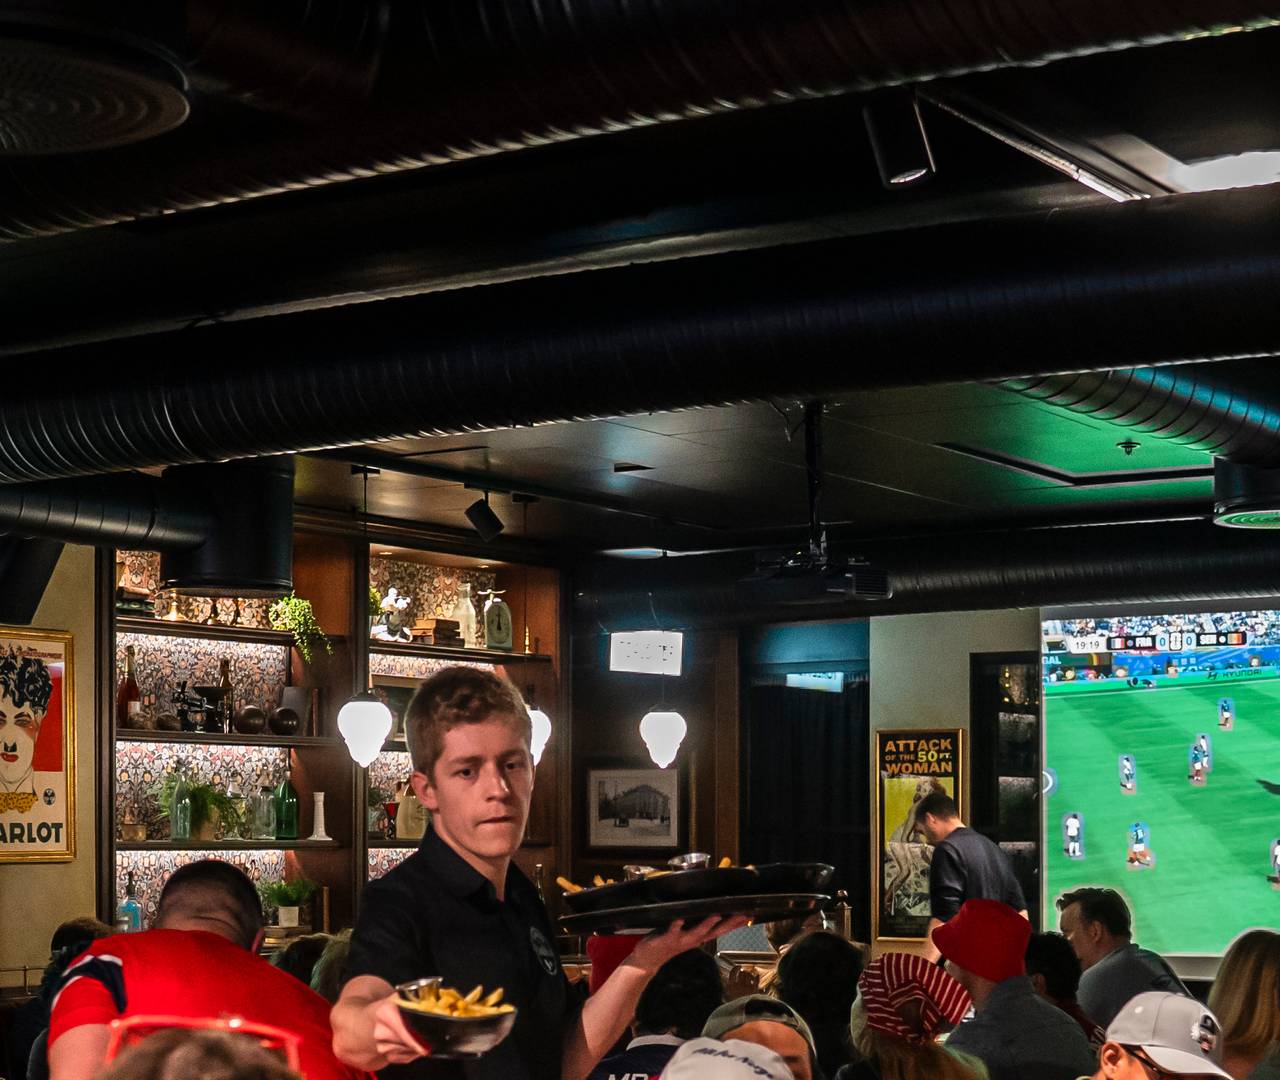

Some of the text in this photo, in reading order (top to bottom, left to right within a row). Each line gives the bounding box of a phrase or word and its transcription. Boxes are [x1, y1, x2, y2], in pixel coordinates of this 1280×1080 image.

[1075, 640, 1100, 650] 19:19
[1222, 669, 1263, 679] HYUNDAI
[885, 738, 952, 752] ATTACK
[900, 753, 915, 761] THE
[918, 750, 938, 762] 50
[885, 761, 952, 774] WOMAN
